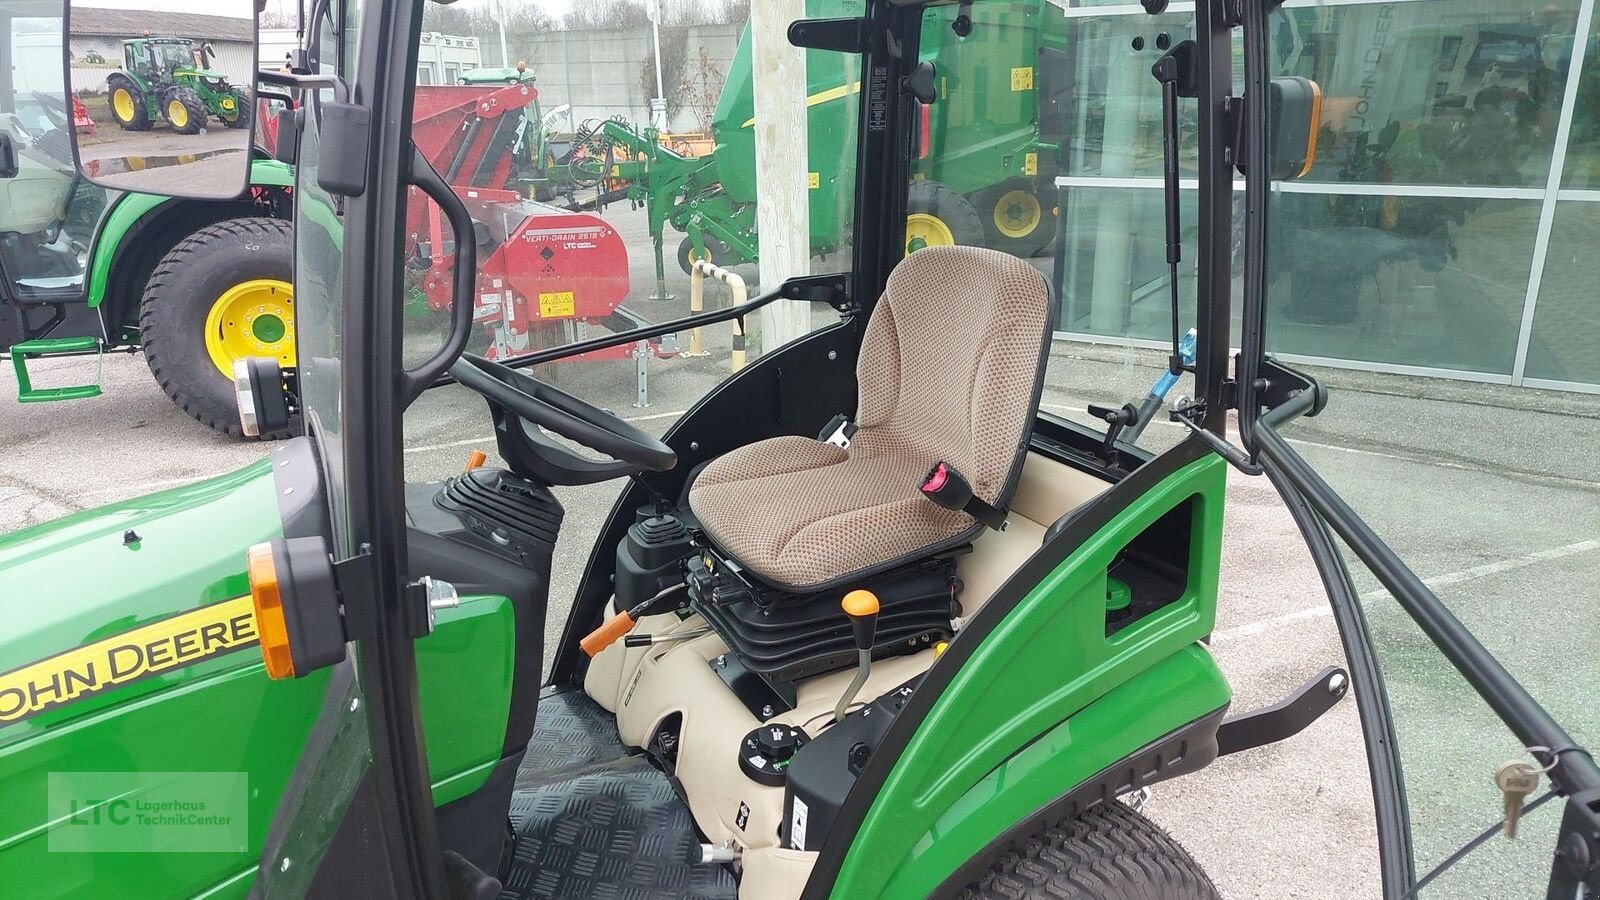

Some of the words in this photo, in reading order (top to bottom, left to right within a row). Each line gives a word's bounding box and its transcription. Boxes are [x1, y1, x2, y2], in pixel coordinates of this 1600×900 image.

[1350, 70, 1377, 127] JOHN
[526, 233, 576, 242] VERTI-DRAIN
[563, 242, 577, 250] LTC
[107, 613, 256, 680] DEERE
